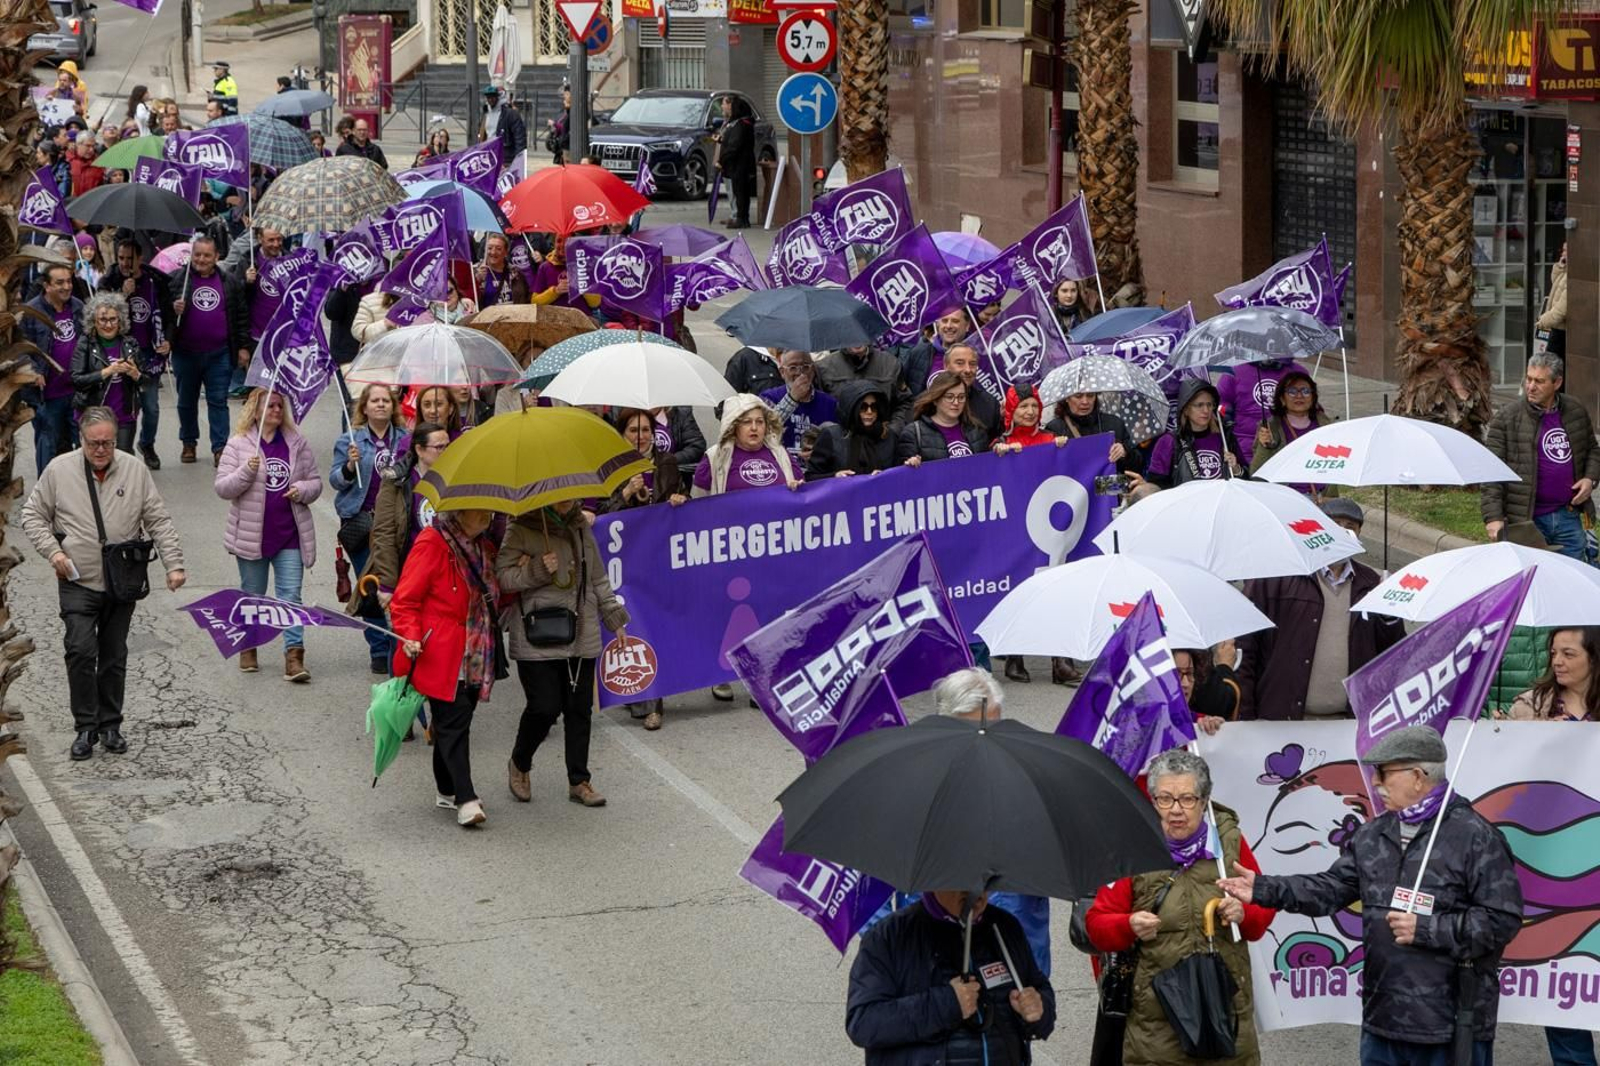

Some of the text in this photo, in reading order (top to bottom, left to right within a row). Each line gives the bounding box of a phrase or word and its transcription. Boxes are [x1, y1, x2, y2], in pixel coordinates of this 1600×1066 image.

[791, 30, 826, 51] 5.7 m
[1540, 79, 1600, 90] TABACOS
[1305, 460, 1345, 470] USTEA
[670, 485, 1008, 570] EMERGENCIA FEMINISTA
[1304, 533, 1335, 549] USTEA
[1382, 588, 1415, 603] USTEA
[605, 644, 647, 670] UGT
[1290, 966, 1347, 998] una
[1499, 967, 1539, 997] en
